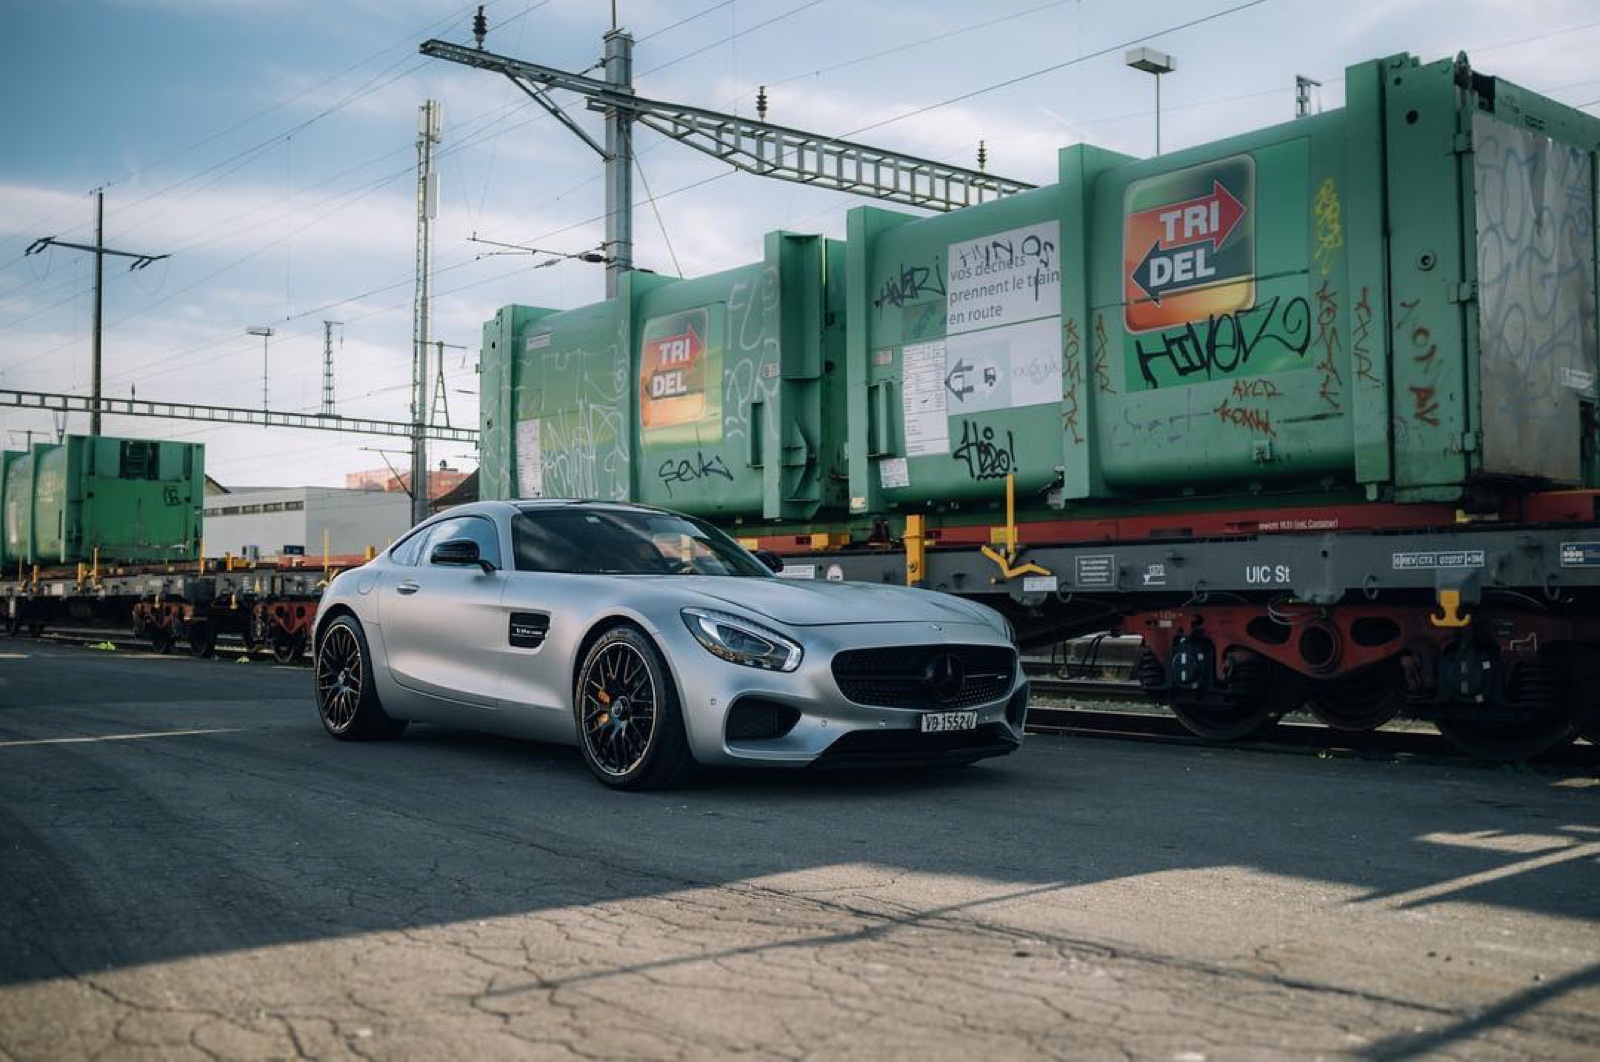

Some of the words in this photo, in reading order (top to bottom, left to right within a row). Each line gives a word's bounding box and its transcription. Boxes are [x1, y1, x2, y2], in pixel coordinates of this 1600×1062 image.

[1159, 200, 1220, 242] TRI
[950, 266, 973, 282] vos
[1149, 248, 1216, 288] DEL
[949, 279, 1009, 307] prennent
[1012, 275, 1025, 291] le
[1027, 268, 1060, 288] train
[949, 311, 965, 325] en
[968, 304, 1003, 321] route
[659, 338, 690, 366] TRI
[652, 371, 687, 398] DEL
[1245, 564, 1271, 583] UIC
[1275, 564, 1291, 583] St
